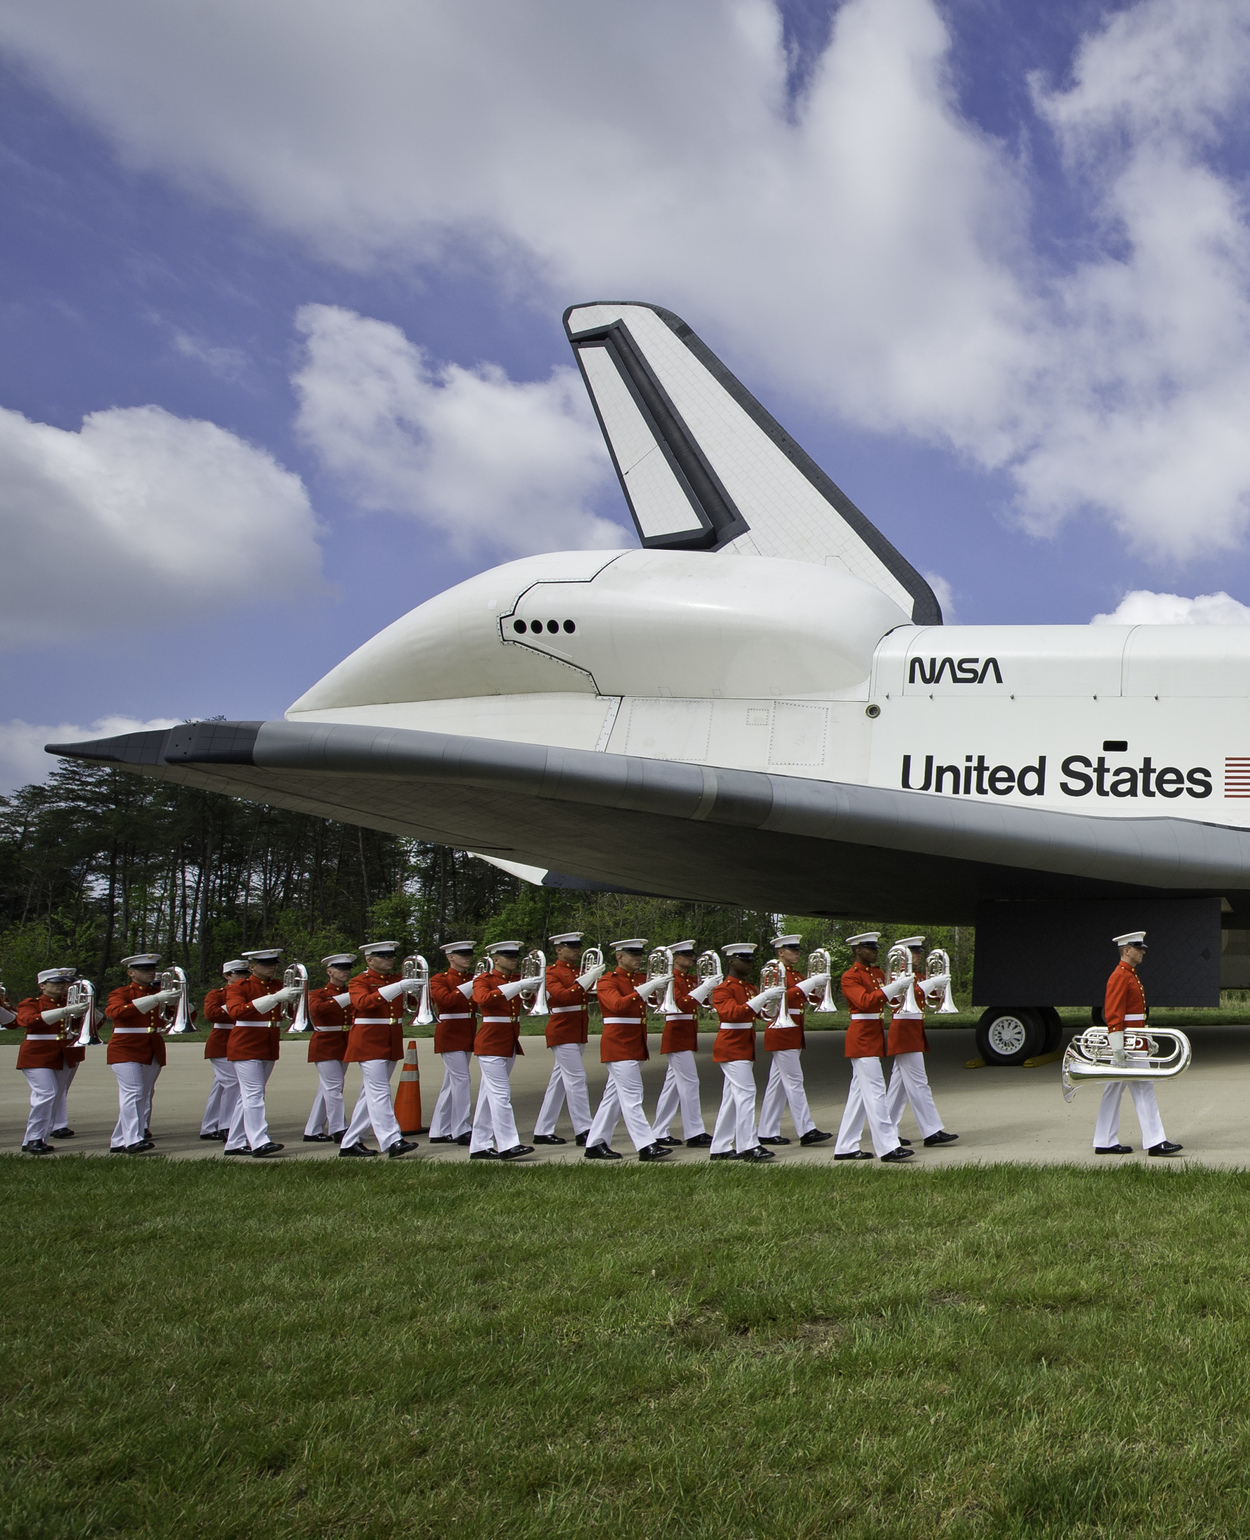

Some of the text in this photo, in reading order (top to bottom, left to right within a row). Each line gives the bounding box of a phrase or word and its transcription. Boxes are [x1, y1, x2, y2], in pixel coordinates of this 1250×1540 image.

[908, 656, 1004, 684] NASA
[901, 755, 1213, 799] United States
